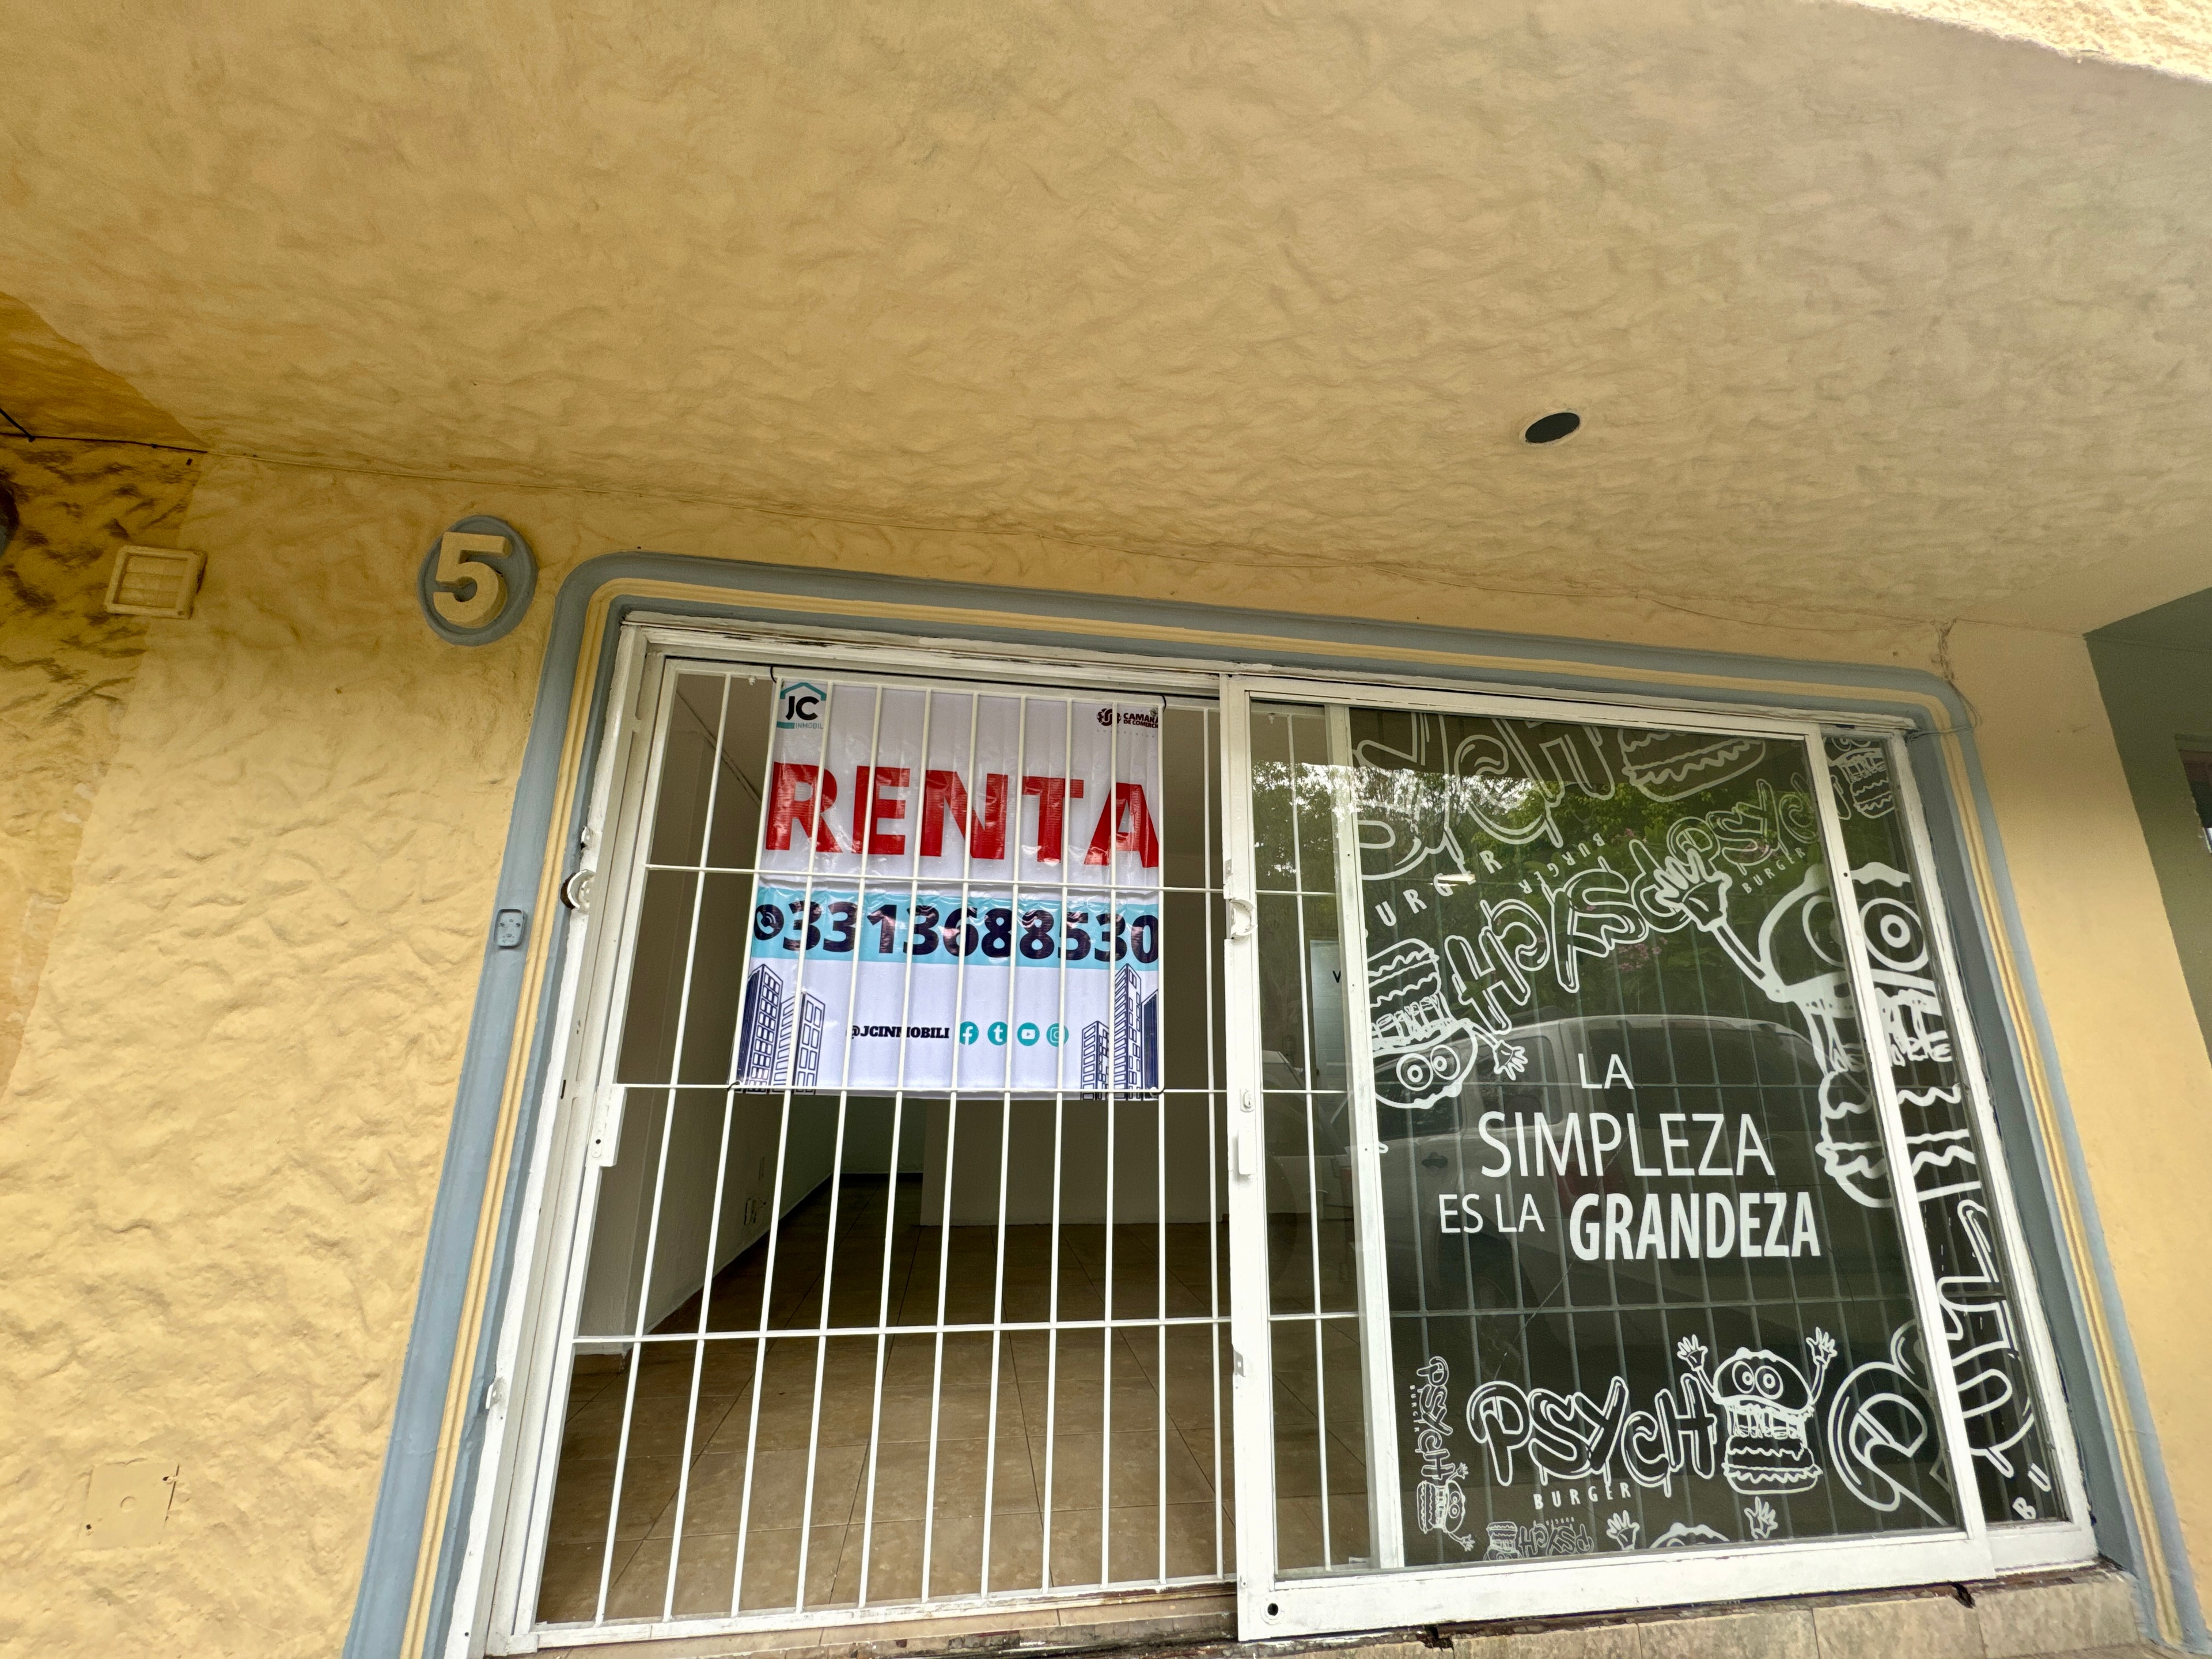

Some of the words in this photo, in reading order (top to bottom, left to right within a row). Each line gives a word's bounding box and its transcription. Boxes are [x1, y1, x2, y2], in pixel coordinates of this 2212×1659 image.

[433, 532, 512, 628] 5
[785, 696, 820, 721] JC
[765, 760, 1160, 869] RENTA
[1366, 850, 1503, 939] URGER
[1518, 832, 1605, 894] BURGER
[1741, 847, 1806, 894] BURGER
[783, 900, 1158, 964] 3313688530
[1580, 1054, 1634, 1089] LA
[1479, 1111, 1775, 1177] SIMPLEZA
[1439, 1193, 1483, 1233] ES
[1497, 1193, 1546, 1233] LA
[1570, 1192, 1821, 1260] GRANDEZA
[1467, 1373, 1717, 1498] PSYCH
[1533, 1482, 1631, 1510] BURGER
